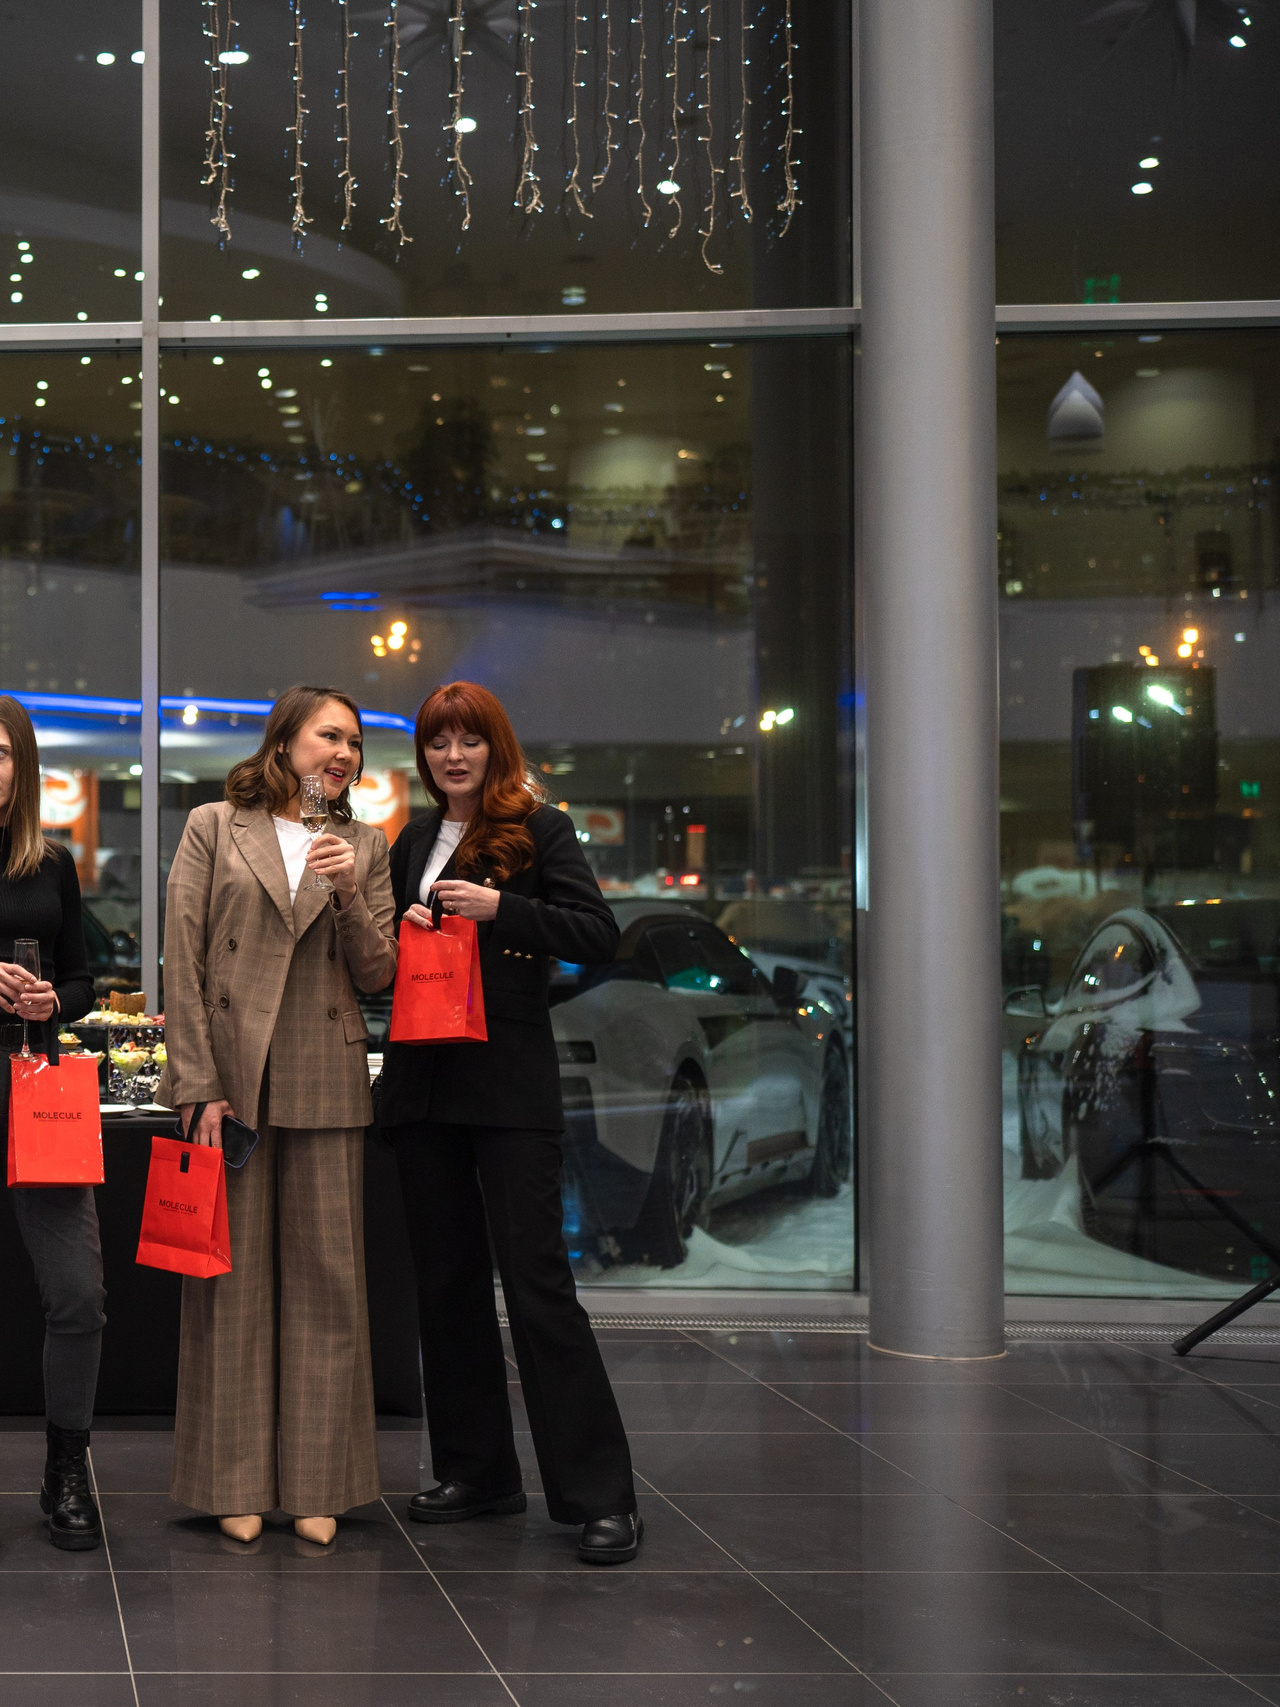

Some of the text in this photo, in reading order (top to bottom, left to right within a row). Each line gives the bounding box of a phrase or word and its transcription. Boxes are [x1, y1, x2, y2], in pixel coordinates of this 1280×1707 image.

[411, 971, 454, 981] MOLECULE
[33, 1111, 82, 1120] MOLECULE
[159, 1199, 198, 1214] MOLECULE
